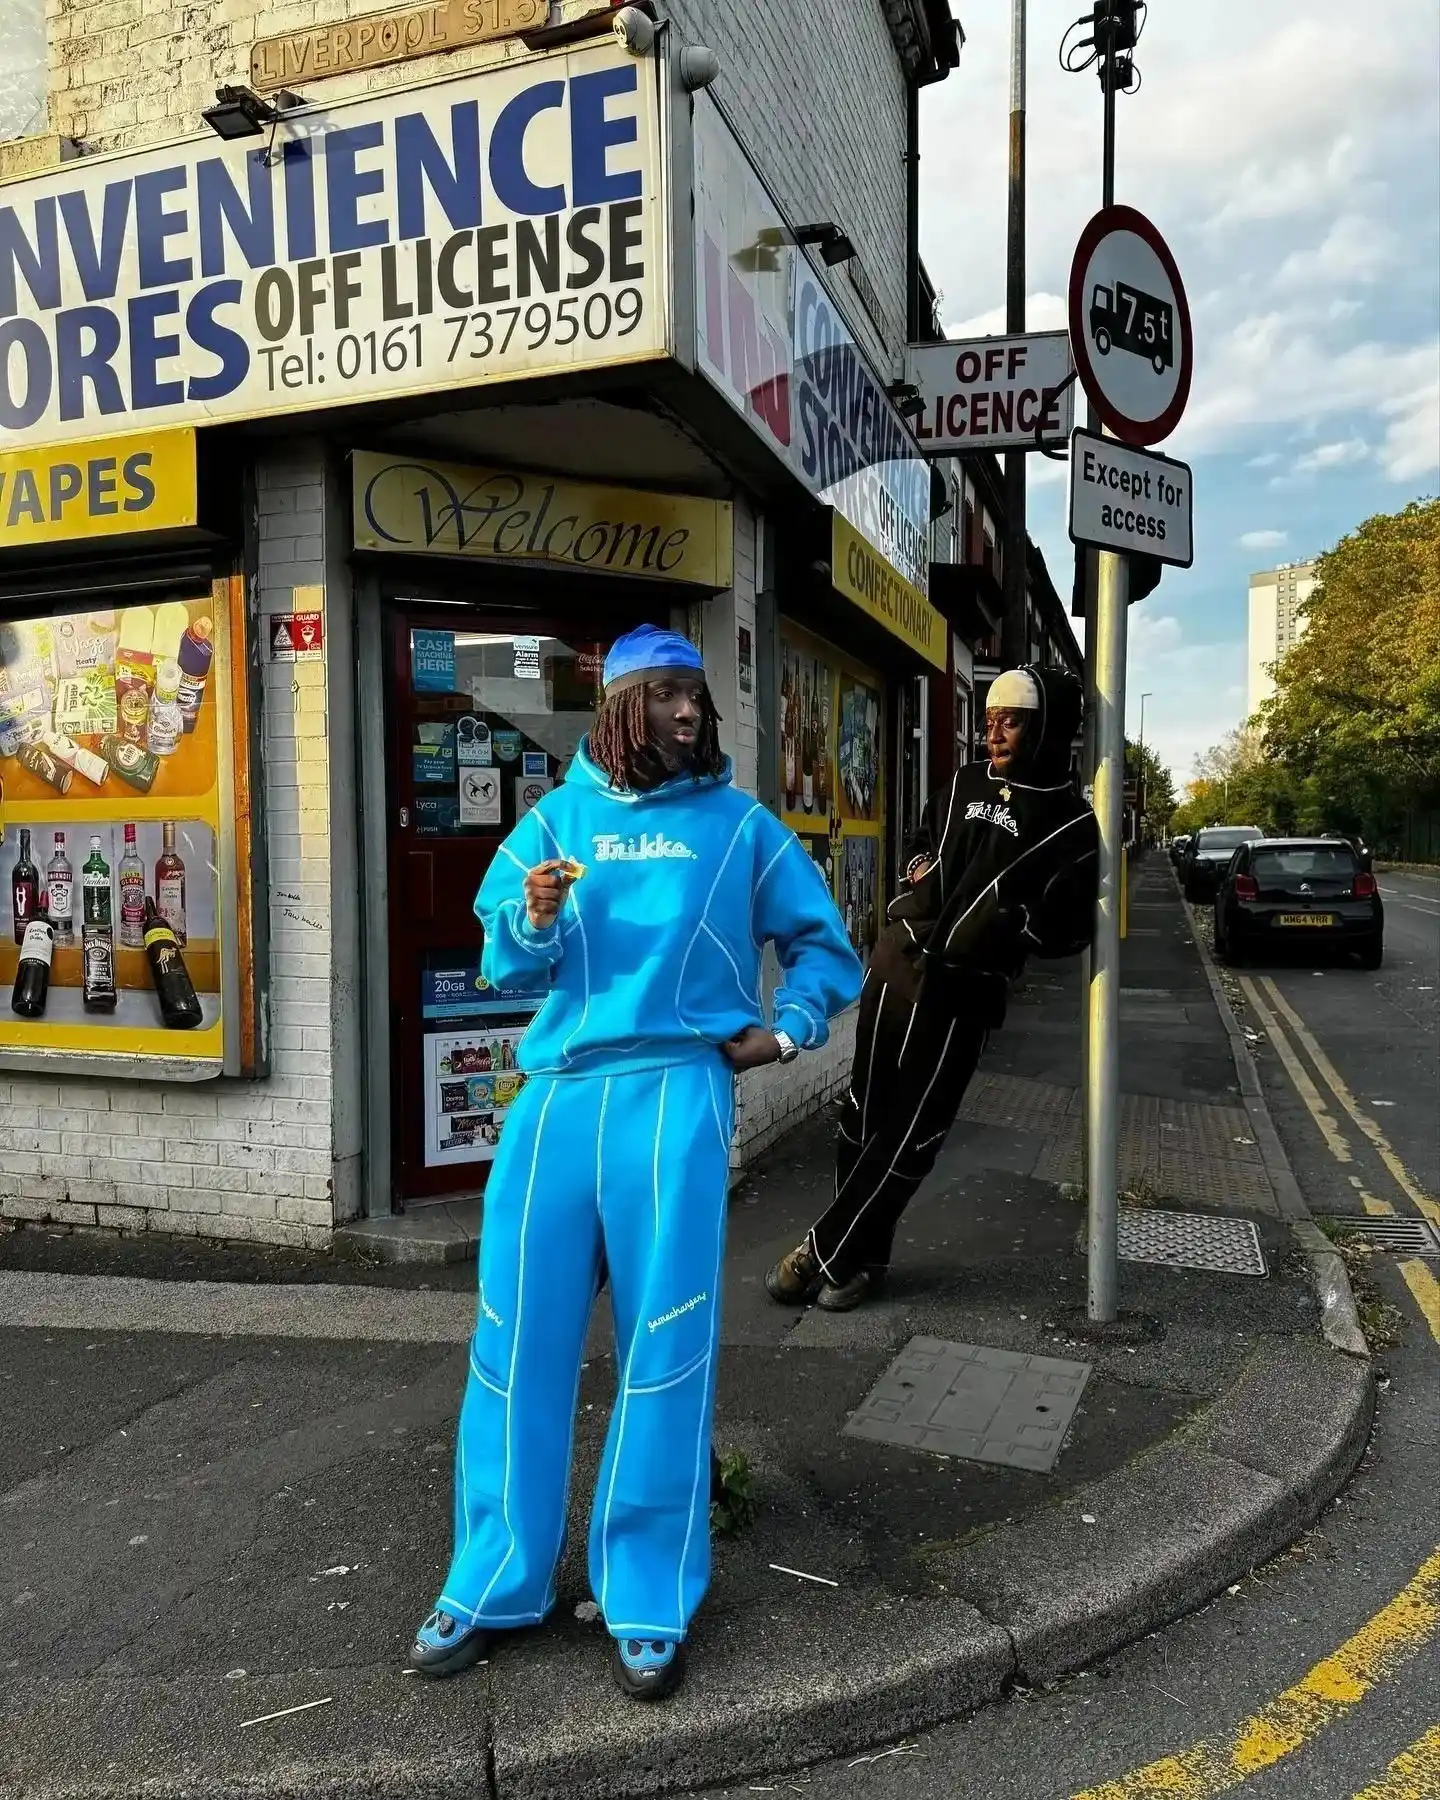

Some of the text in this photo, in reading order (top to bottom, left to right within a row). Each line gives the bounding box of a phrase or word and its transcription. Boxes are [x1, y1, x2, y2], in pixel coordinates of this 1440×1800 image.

[260, 8, 447, 81] LIVERPOOL
[0, 64, 643, 315] NVENIENCE
[254, 200, 644, 342] OFF LICENSE
[0, 279, 251, 430] ORES
[257, 287, 643, 391] Tel: 0161 7379509
[954, 347, 1028, 385] OFF
[916, 387, 1060, 439] LICENCE
[0, 452, 156, 527] APES
[1083, 451, 1183, 508] Except for
[364, 463, 690, 573] Welcome
[1101, 503, 1166, 541] access
[847, 540, 933, 648] CONFECTIONARY
[416, 639, 453, 652] CASH
[416, 651, 454, 659] MACHINE
[416, 658, 454, 671] HERE
[515, 650, 539, 658] Alarm
[70, 683, 78, 711] ARIEL
[416, 800, 437, 811] Lyca
[434, 980, 466, 992] 20GB
